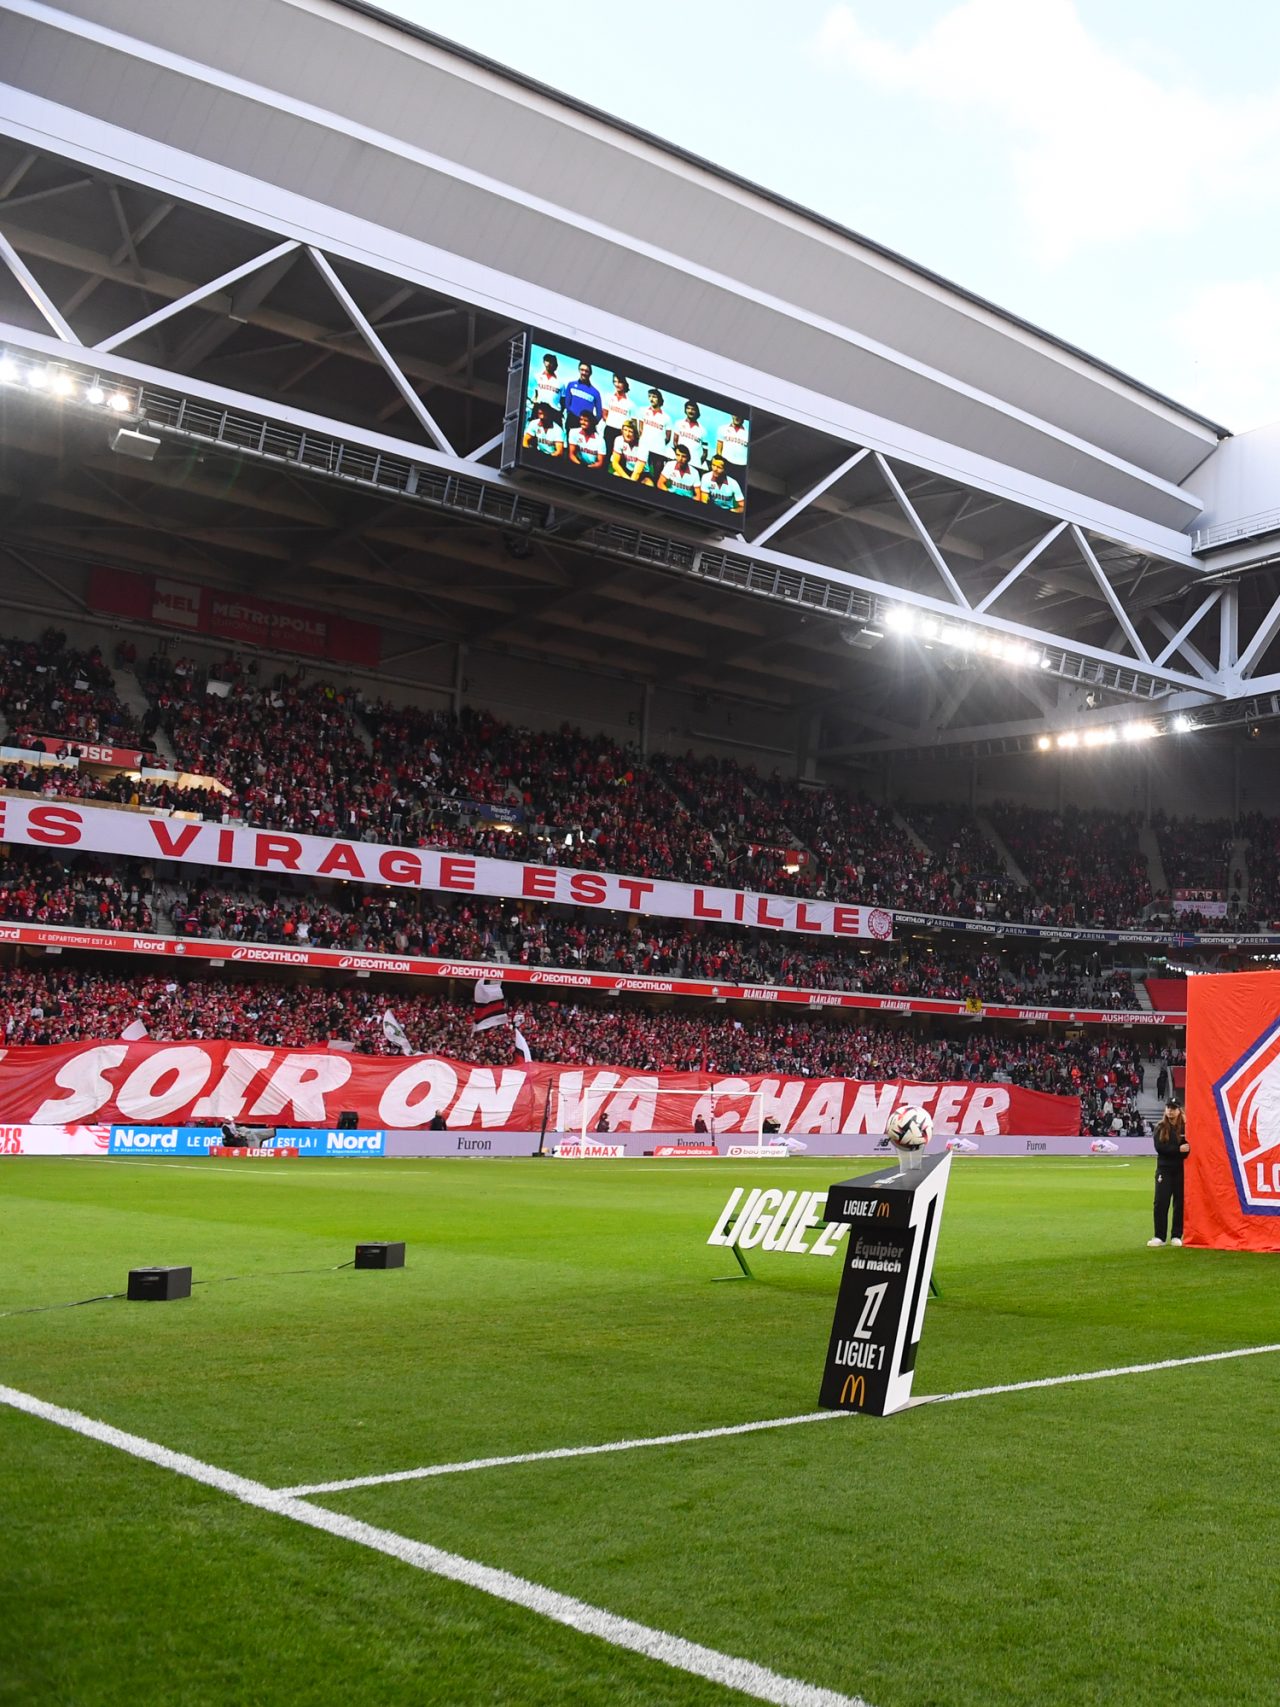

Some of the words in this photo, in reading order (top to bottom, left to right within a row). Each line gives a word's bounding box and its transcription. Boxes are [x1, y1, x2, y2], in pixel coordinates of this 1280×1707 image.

[153, 591, 198, 614] MEL
[211, 599, 327, 636] MÉTROPOLE
[149, 819, 476, 890] VIRAGE
[522, 866, 654, 909] EST
[693, 889, 859, 934] LILLE
[895, 914, 925, 924] DECATHLON
[934, 920, 954, 928] ARENA
[965, 923, 995, 932] DECATHLON
[1039, 930, 1072, 938] DECATHLON
[133, 939, 165, 951] Nord
[248, 949, 308, 963] DECATHLON
[353, 957, 410, 972] DECATHLON
[452, 965, 504, 978] DECATHLON
[542, 973, 592, 985] DECATHLON
[627, 980, 672, 991] DECATHLON
[30, 1045, 352, 1125] SOIR
[379, 1059, 526, 1128] ON
[557, 1071, 658, 1132] VA
[692, 1077, 1010, 1135] CHANTER
[114, 1129, 178, 1148] Nord
[187, 1136, 199, 1147] LE
[277, 1138, 296, 1148] EST
[327, 1132, 381, 1149] Nord
[457, 1137, 491, 1150] Furon
[1026, 1140, 1047, 1151] Furon
[246, 1148, 275, 1157] LOSC
[559, 1146, 618, 1157] WINAMAX
[843, 1200, 868, 1217] LIGUE
[706, 1187, 828, 1254] LIGUE
[855, 1236, 904, 1260] Équipier
[851, 1257, 865, 1270] du
[866, 1258, 902, 1273] match
[834, 1340, 876, 1370] LIGUE
[877, 1345, 886, 1371] 1
